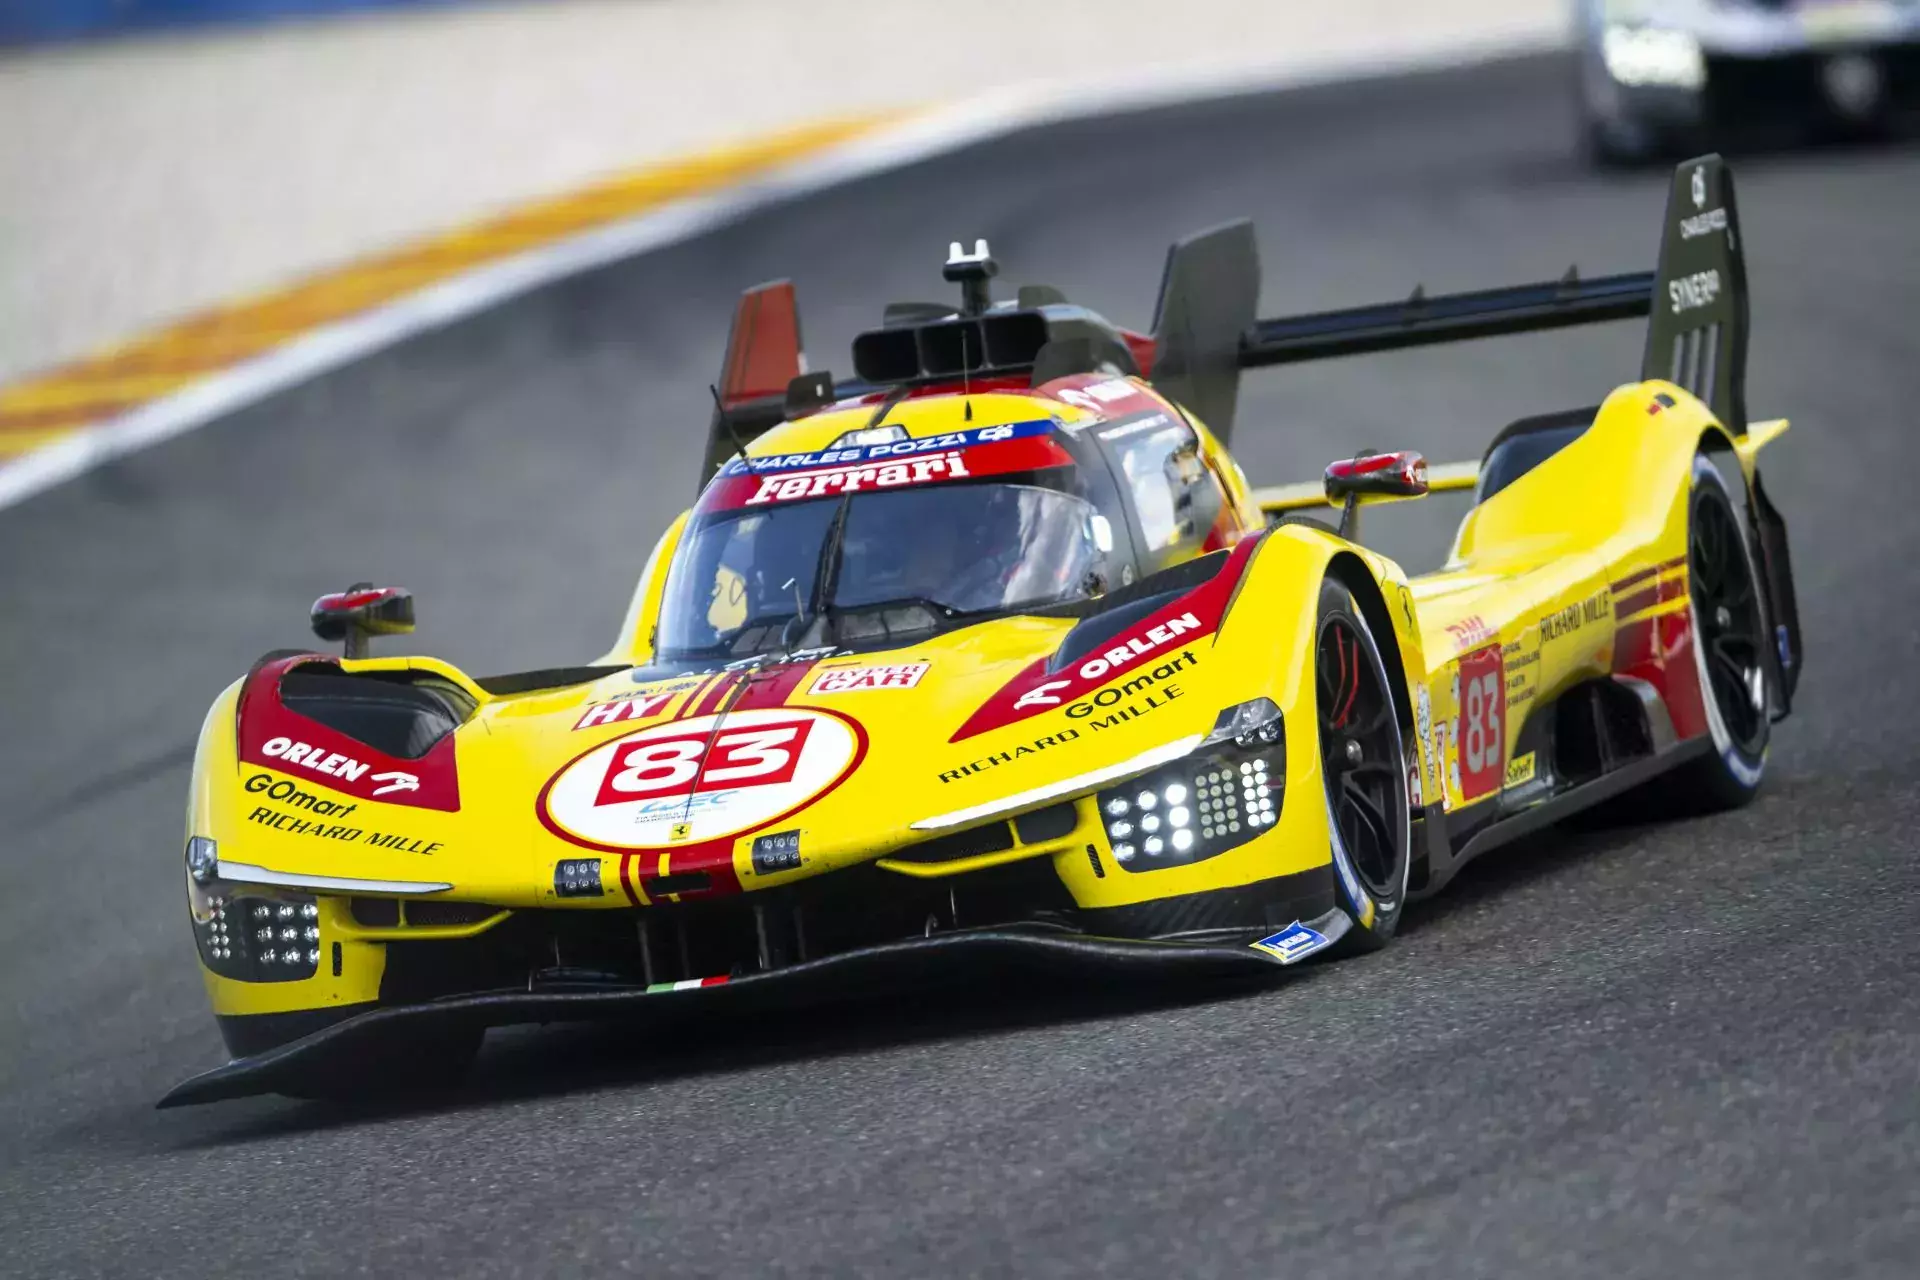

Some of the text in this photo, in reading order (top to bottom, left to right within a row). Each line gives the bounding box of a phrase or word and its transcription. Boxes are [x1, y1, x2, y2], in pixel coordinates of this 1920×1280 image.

[729, 432, 966, 475] CHARLES POZZI
[745, 450, 970, 505] Ferrari
[1080, 612, 1202, 680] ORLEN
[818, 673, 913, 691] CAR
[826, 665, 920, 680] HYPER
[1065, 651, 1198, 719] GOmart
[578, 694, 671, 730] HY
[938, 683, 1185, 784] RICHARD MILLE
[1466, 671, 1500, 774] 83
[262, 737, 370, 782] ORLEN
[611, 727, 799, 793] 83
[244, 774, 358, 819] GOmart
[248, 806, 444, 856] RICHARD MILLE
